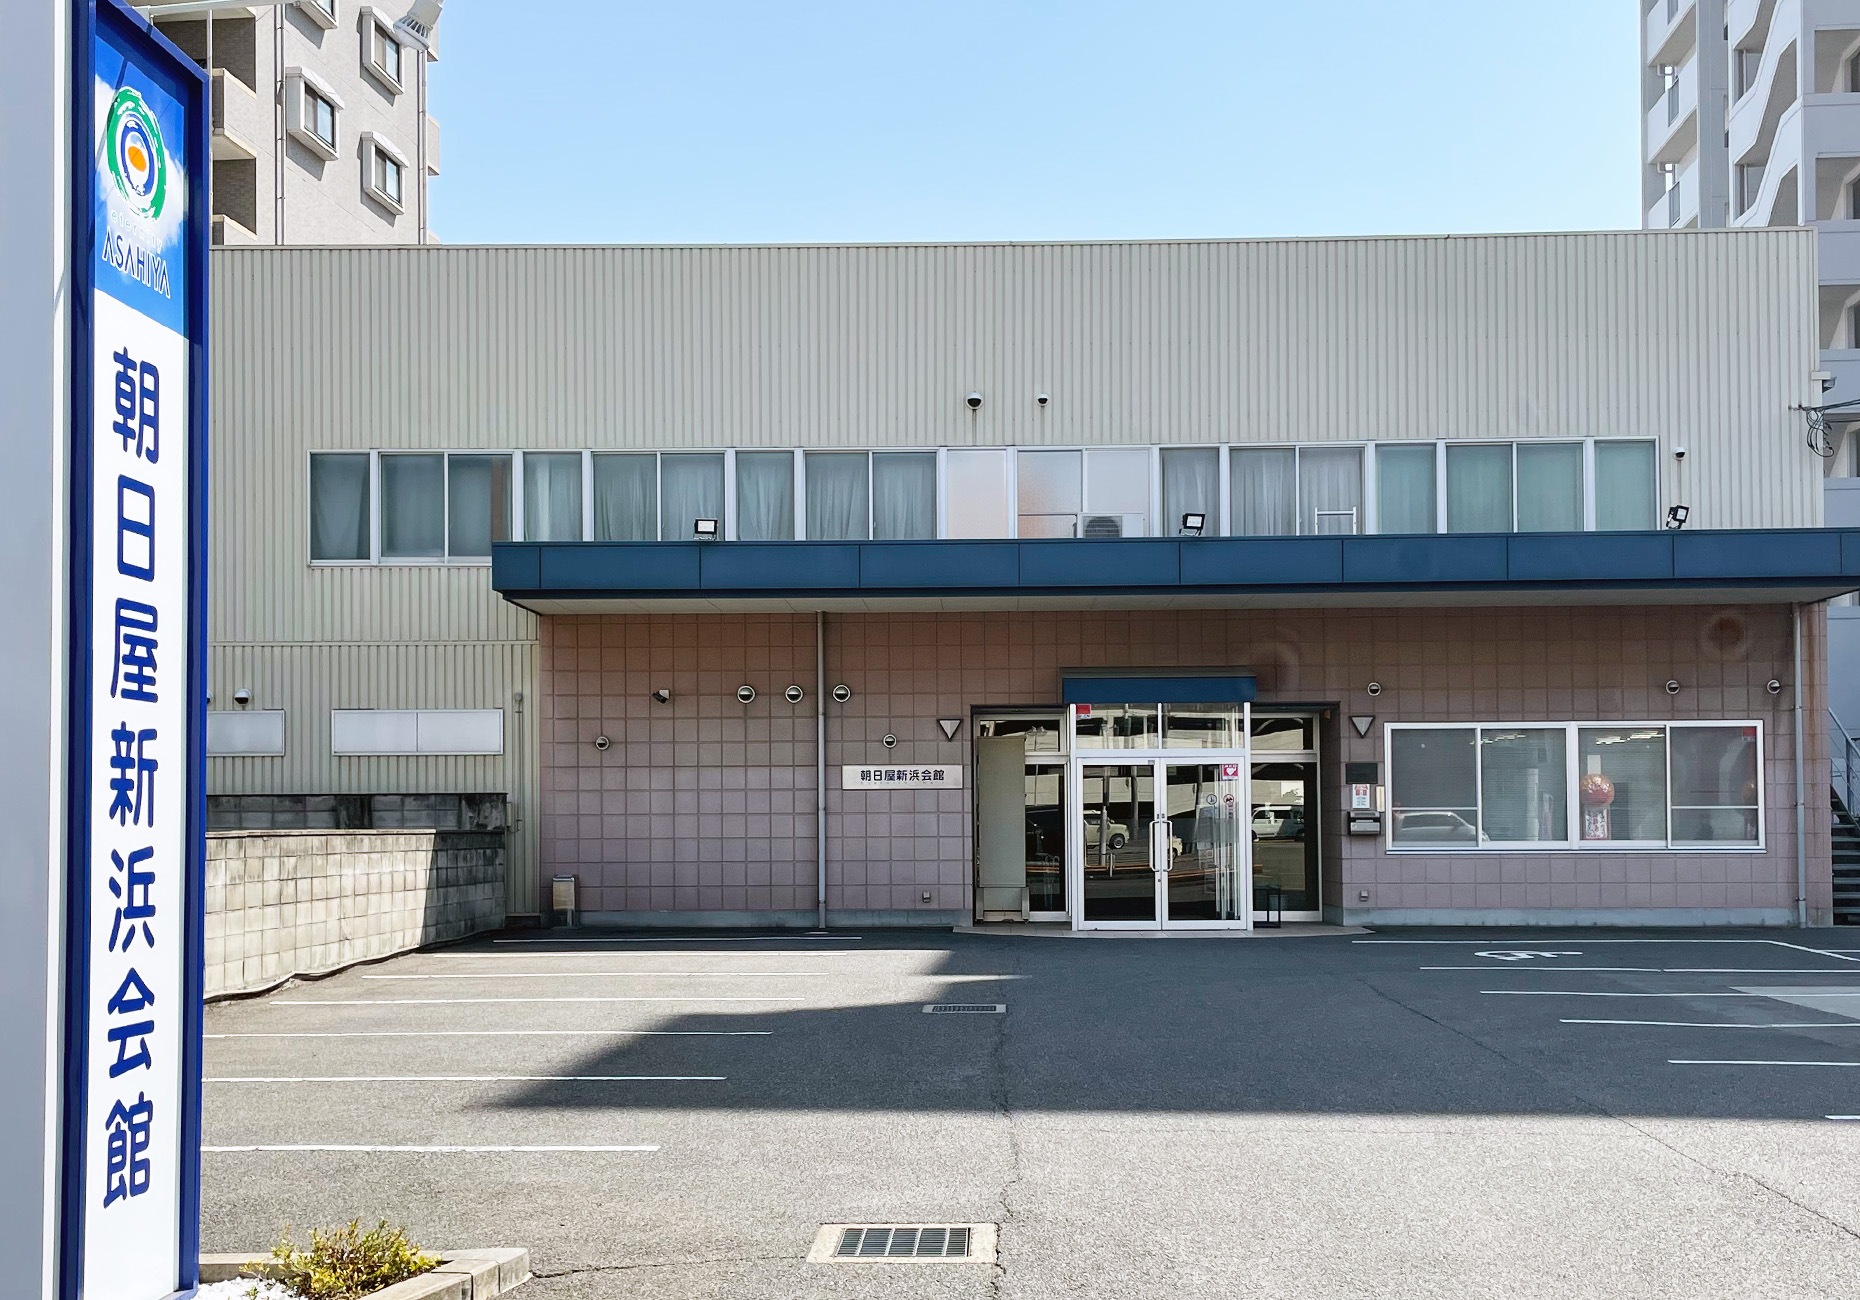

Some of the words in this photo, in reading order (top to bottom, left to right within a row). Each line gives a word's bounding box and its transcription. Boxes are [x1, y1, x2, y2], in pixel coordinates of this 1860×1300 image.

[102, 226, 171, 298] ASAHIYA
[103, 346, 160, 1209] 朝日屋新浜会館
[860, 769, 945, 781] 朝日屋新浜会館
